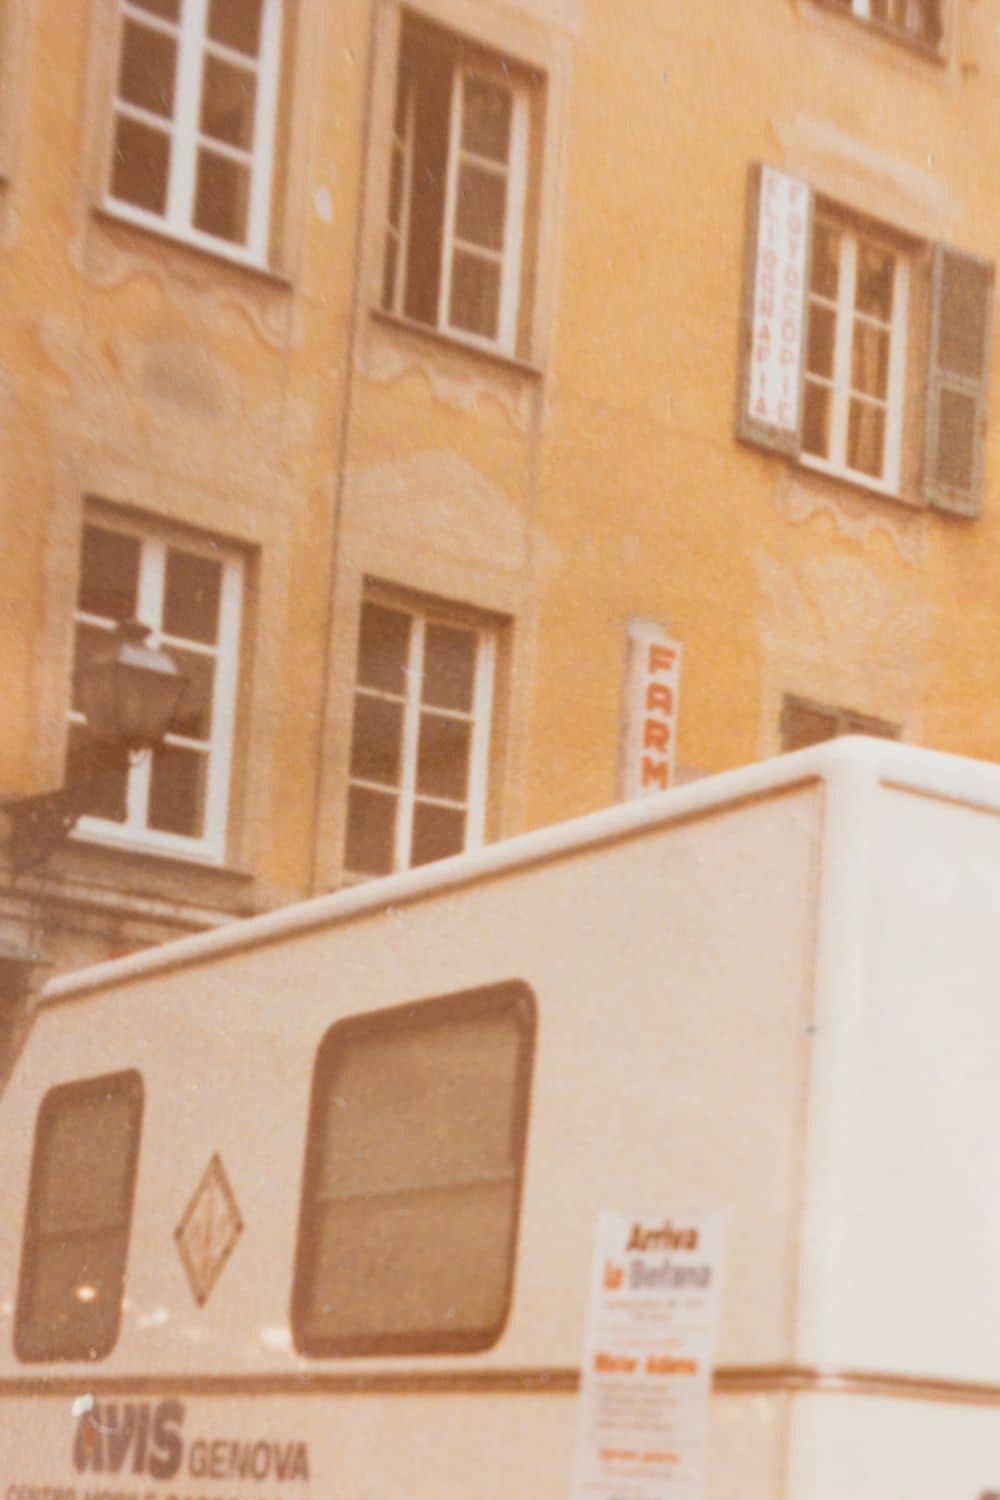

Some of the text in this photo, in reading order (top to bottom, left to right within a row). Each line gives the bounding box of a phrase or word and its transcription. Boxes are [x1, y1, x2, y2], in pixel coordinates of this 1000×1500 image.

[626, 1220, 699, 1252] Arriva
[603, 1257, 713, 1291] la Befana
[72, 1399, 311, 1483] AVIS GENOVA
